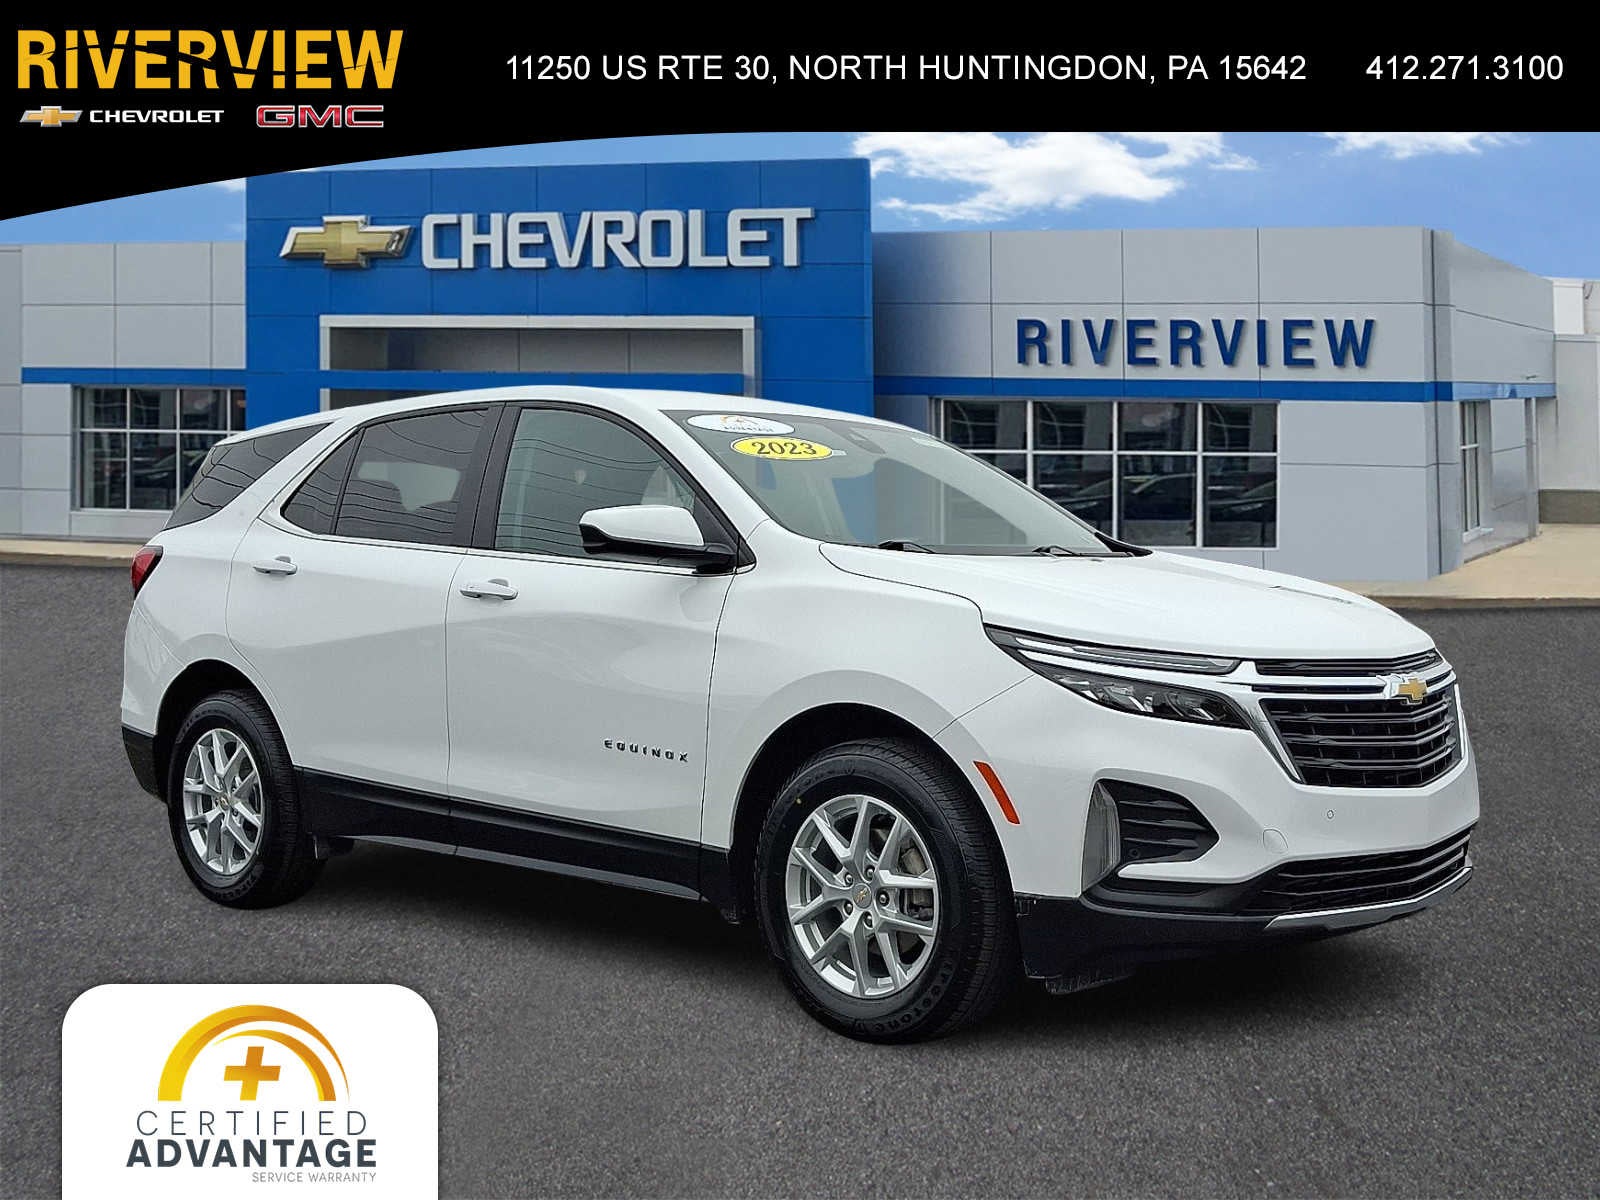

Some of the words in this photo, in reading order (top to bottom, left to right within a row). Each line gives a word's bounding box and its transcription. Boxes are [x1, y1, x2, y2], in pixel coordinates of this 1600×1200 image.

[421, 207, 815, 270] CHEVROLET
[1016, 318, 1376, 369] RIVERVIEW
[751, 441, 817, 456] 2023
[603, 738, 689, 763] EQUINOX
